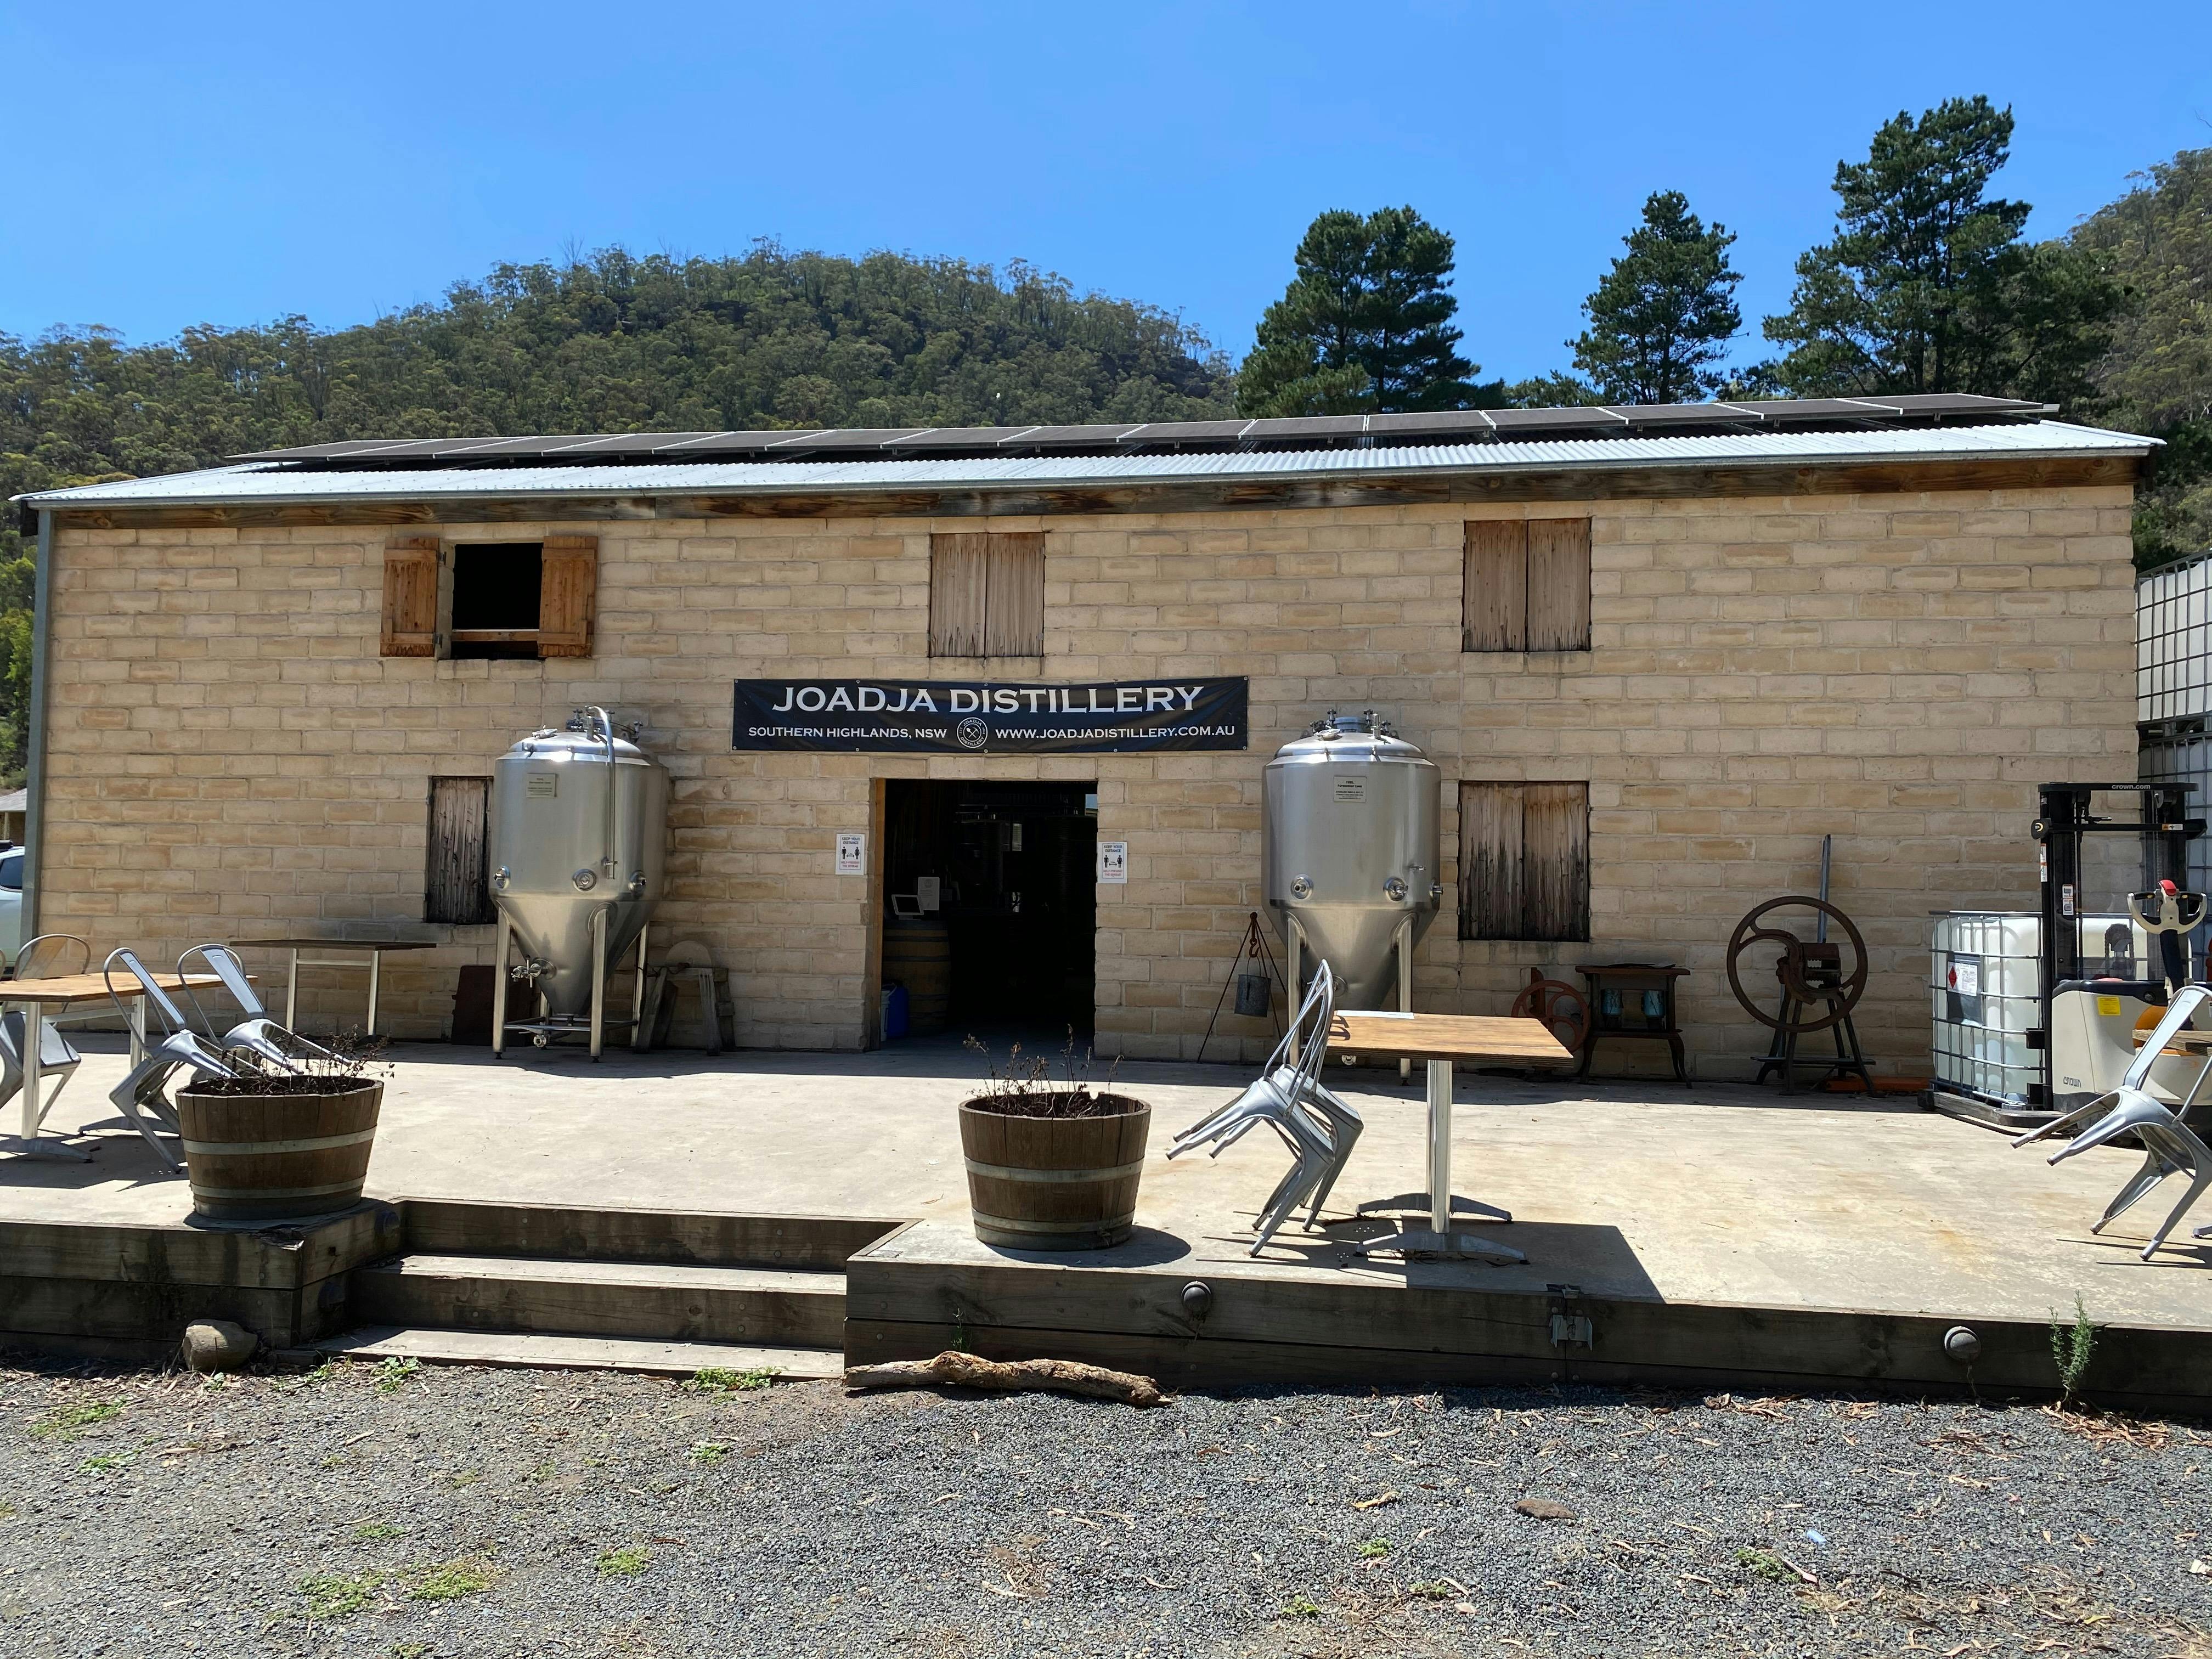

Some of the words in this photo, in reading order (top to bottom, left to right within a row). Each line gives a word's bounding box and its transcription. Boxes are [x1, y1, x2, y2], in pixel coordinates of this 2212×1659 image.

[772, 687, 939, 712] JOADJA
[949, 686, 1204, 713] DISTILLERY
[748, 727, 823, 738] SOUTHERN
[826, 727, 912, 740] HIGHLANDS,
[915, 729, 947, 739] NSW
[995, 726, 1235, 739] WWW.JOADJADISTILLERY.COM.AU
[960, 736, 985, 746] DISTILLERY
